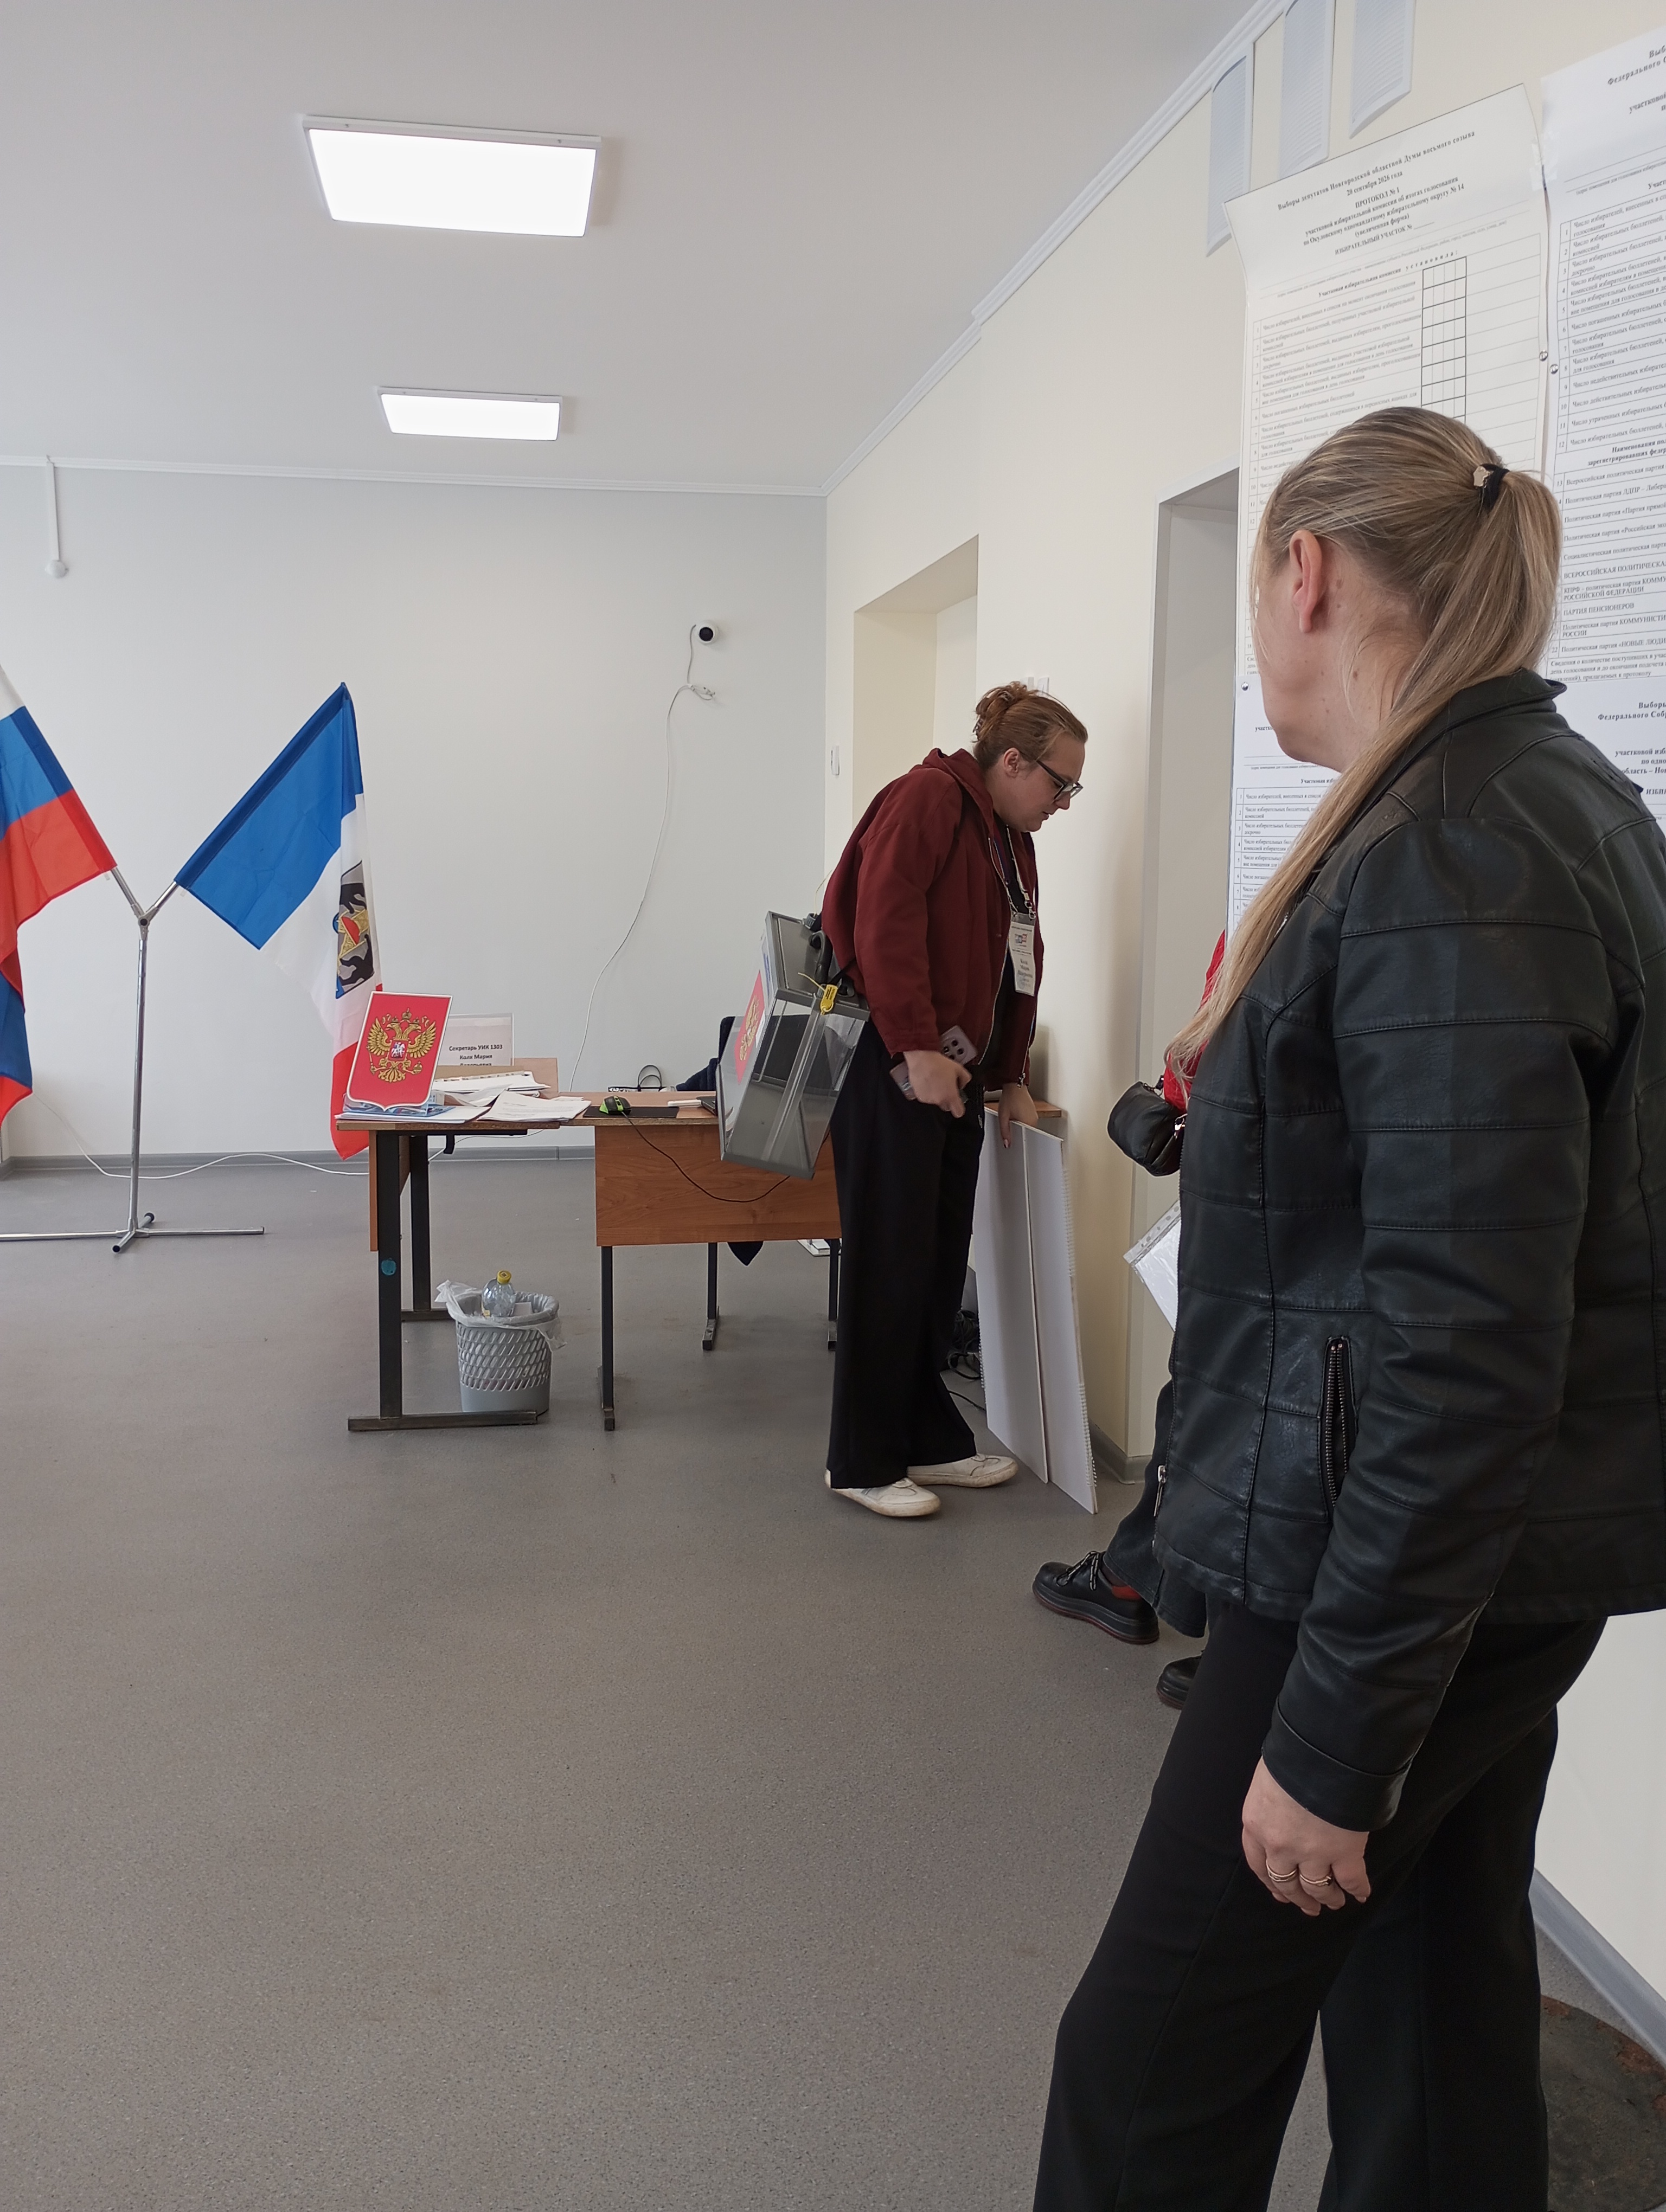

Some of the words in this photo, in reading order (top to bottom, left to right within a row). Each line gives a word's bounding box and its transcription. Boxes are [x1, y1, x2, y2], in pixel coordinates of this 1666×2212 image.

[1649, 46, 1666, 58] Выб
[1608, 61, 1661, 85] Федерального
[1278, 198, 1299, 210] Выборы
[1302, 188, 1329, 201] депутатов
[1330, 170, 1370, 190] Новгородской
[1372, 158, 1402, 173] областной
[1405, 152, 1421, 163] Думы
[1423, 141, 1451, 155] восьмого
[1453, 132, 1474, 143] созыва
[1354, 181, 1377, 193] сентября
[1305, 222, 1333, 236] участковой
[1334, 208, 1371, 225] избирательной
[1373, 199, 1397, 211] комиссии
[1406, 190, 1422, 200] итогах
[1424, 177, 1458, 193] голосования
[1356, 191, 1388, 208] ПРОТОКОЛ
[1310, 229, 1342, 243] Окуловскому
[1344, 214, 1385, 231] одномандатному
[1387, 198, 1428, 216] избирательному
[1431, 191, 1448, 200] округу
[1355, 221, 1389, 237] (увеличенная
[1391, 214, 1409, 226] форма)
[1335, 235, 1379, 255] ИЗБИРАТЕЛЬНЫЙ
[1381, 226, 1405, 239] УЧАСТОК
[1612, 441, 1655, 453] Наименования
[1588, 451, 1648, 466] зарегистрировавших
[1650, 448, 1666, 456] федер
[1567, 475, 1605, 485] Всероссийская
[1607, 468, 1643, 478] политическая
[1565, 494, 1601, 504] Политическая
[1565, 513, 1600, 523] Политическая
[1565, 532, 1600, 541] Политическая
[1621, 524, 1655, 533] «Российская
[1564, 550, 1611, 560] Социалистическая
[1613, 545, 1649, 554] политическая
[1565, 567, 1616, 578] ВСЕРОССИЙСКАЯ
[1564, 590, 1604, 600] РОССИЙСКОЙ
[1606, 586, 1644, 596] ФЕДЕРАЦИИ
[1589, 603, 1634, 613] ПЕНСИОНЕРОВ
[1615, 749, 1652, 757] участковой
